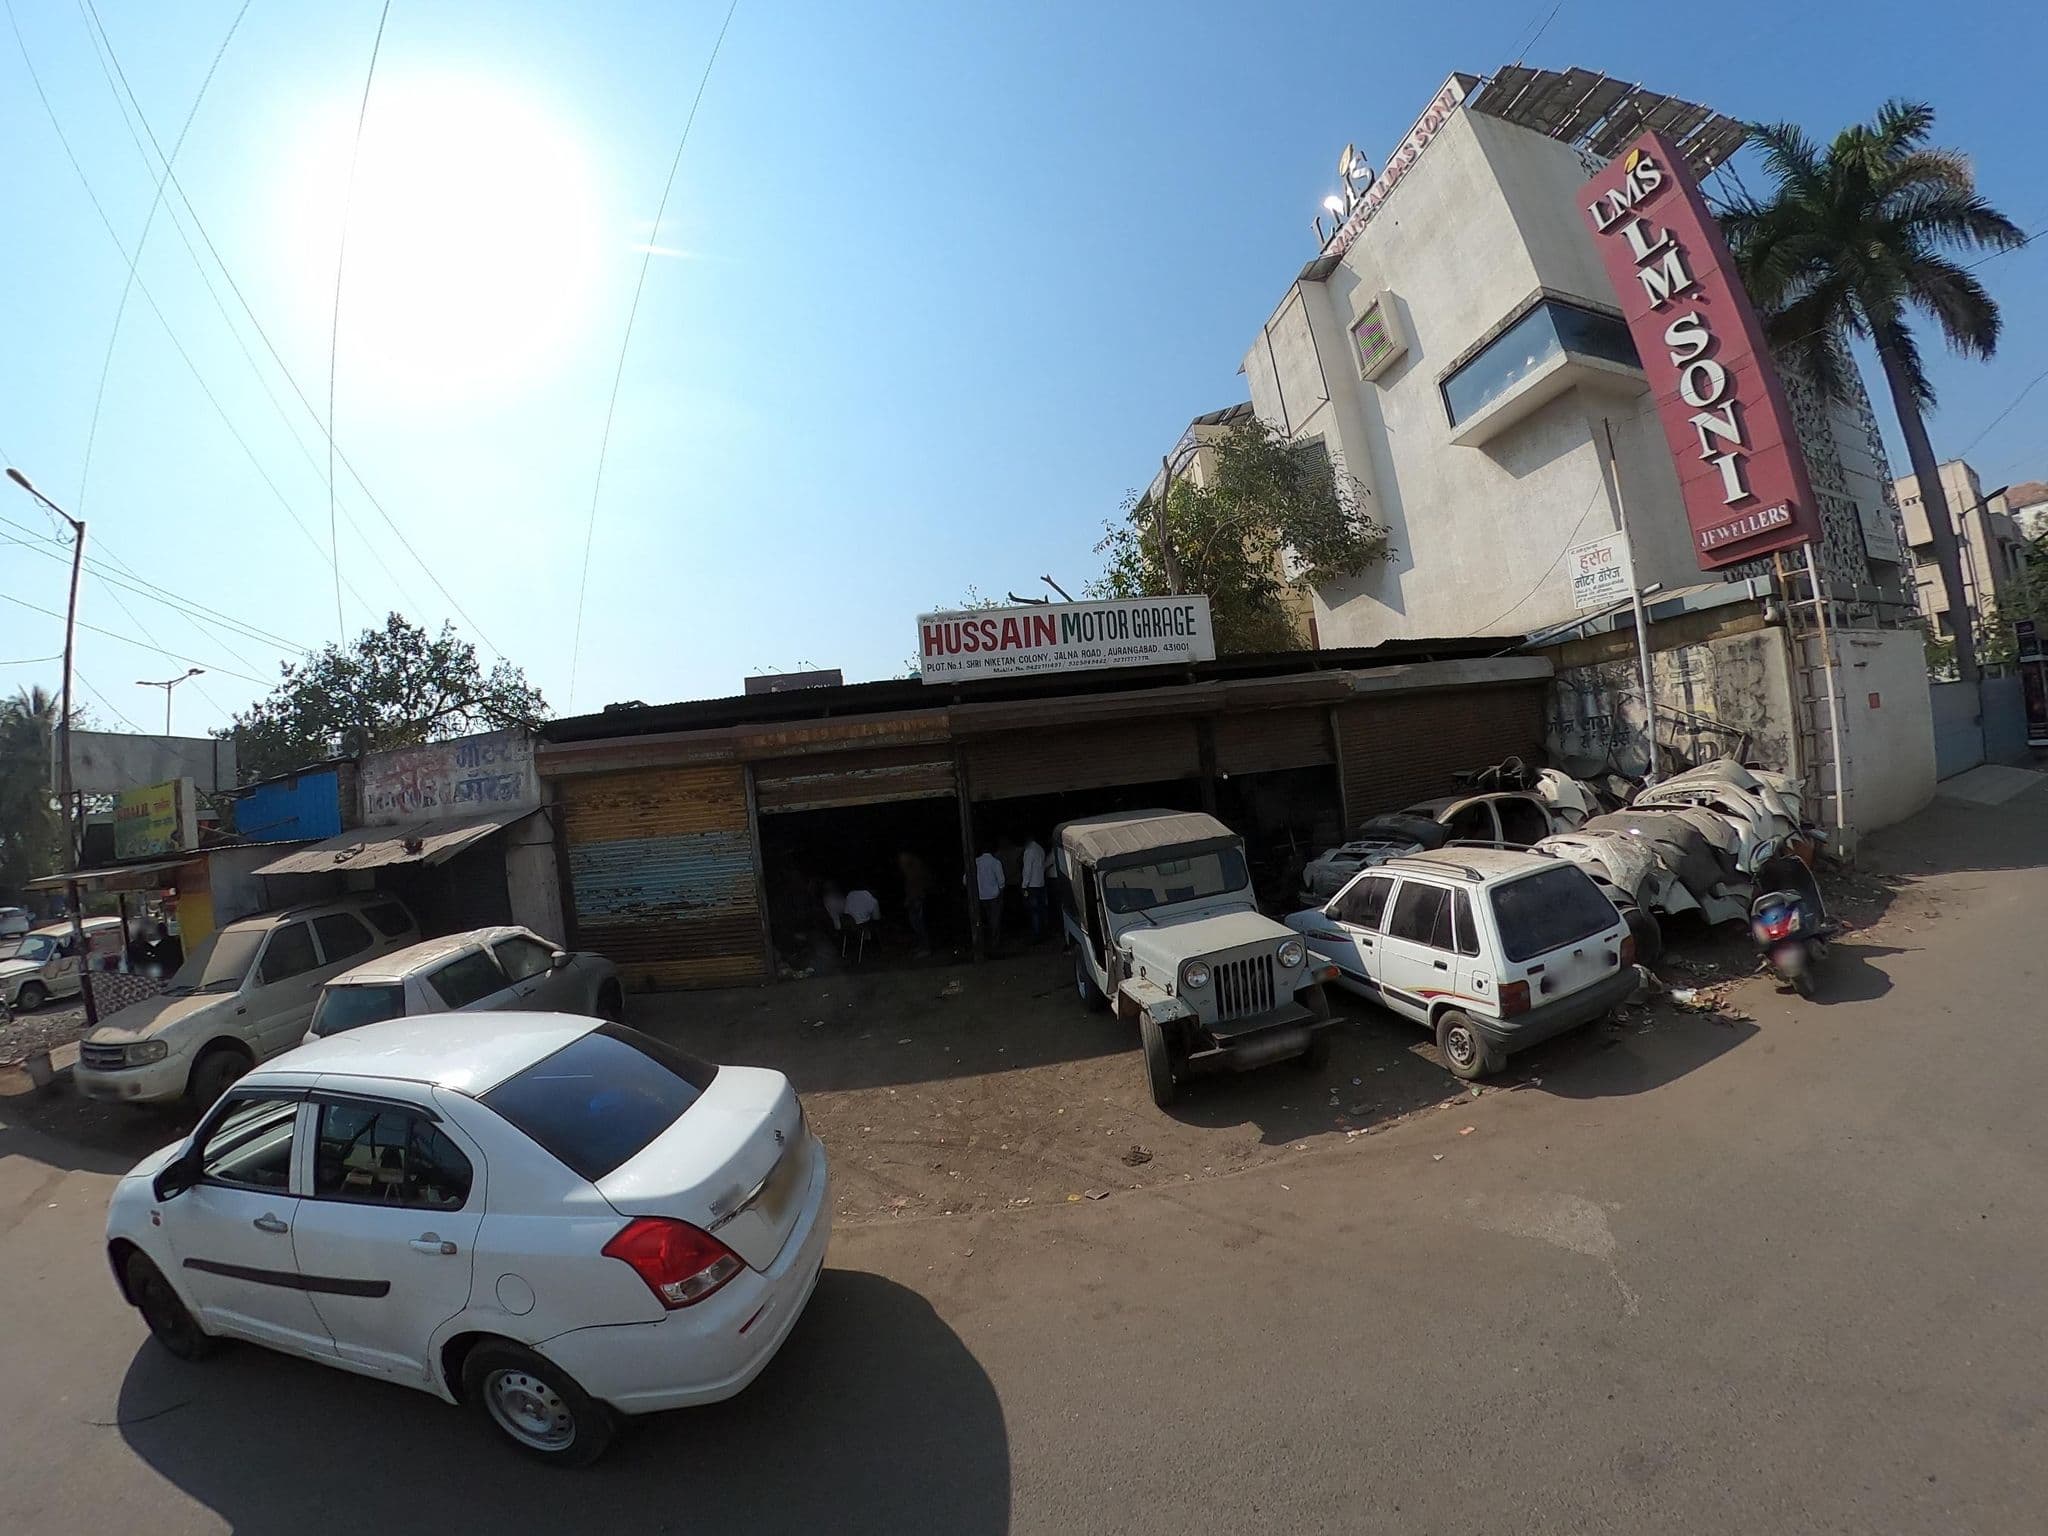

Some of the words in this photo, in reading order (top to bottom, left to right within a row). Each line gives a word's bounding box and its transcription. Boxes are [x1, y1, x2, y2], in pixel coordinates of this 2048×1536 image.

[1587, 156, 1663, 232] LMS
[1700, 504, 1790, 549] JEWELLERS
[923, 614, 1057, 657] HUSSAIN
[1061, 608, 1130, 644] MOTOR
[1132, 606, 1197, 639] GARAGE
[966, 660, 982, 669] SHRI
[984, 656, 1016, 667] NIKETAN
[1054, 650, 1079, 660] JALNA
